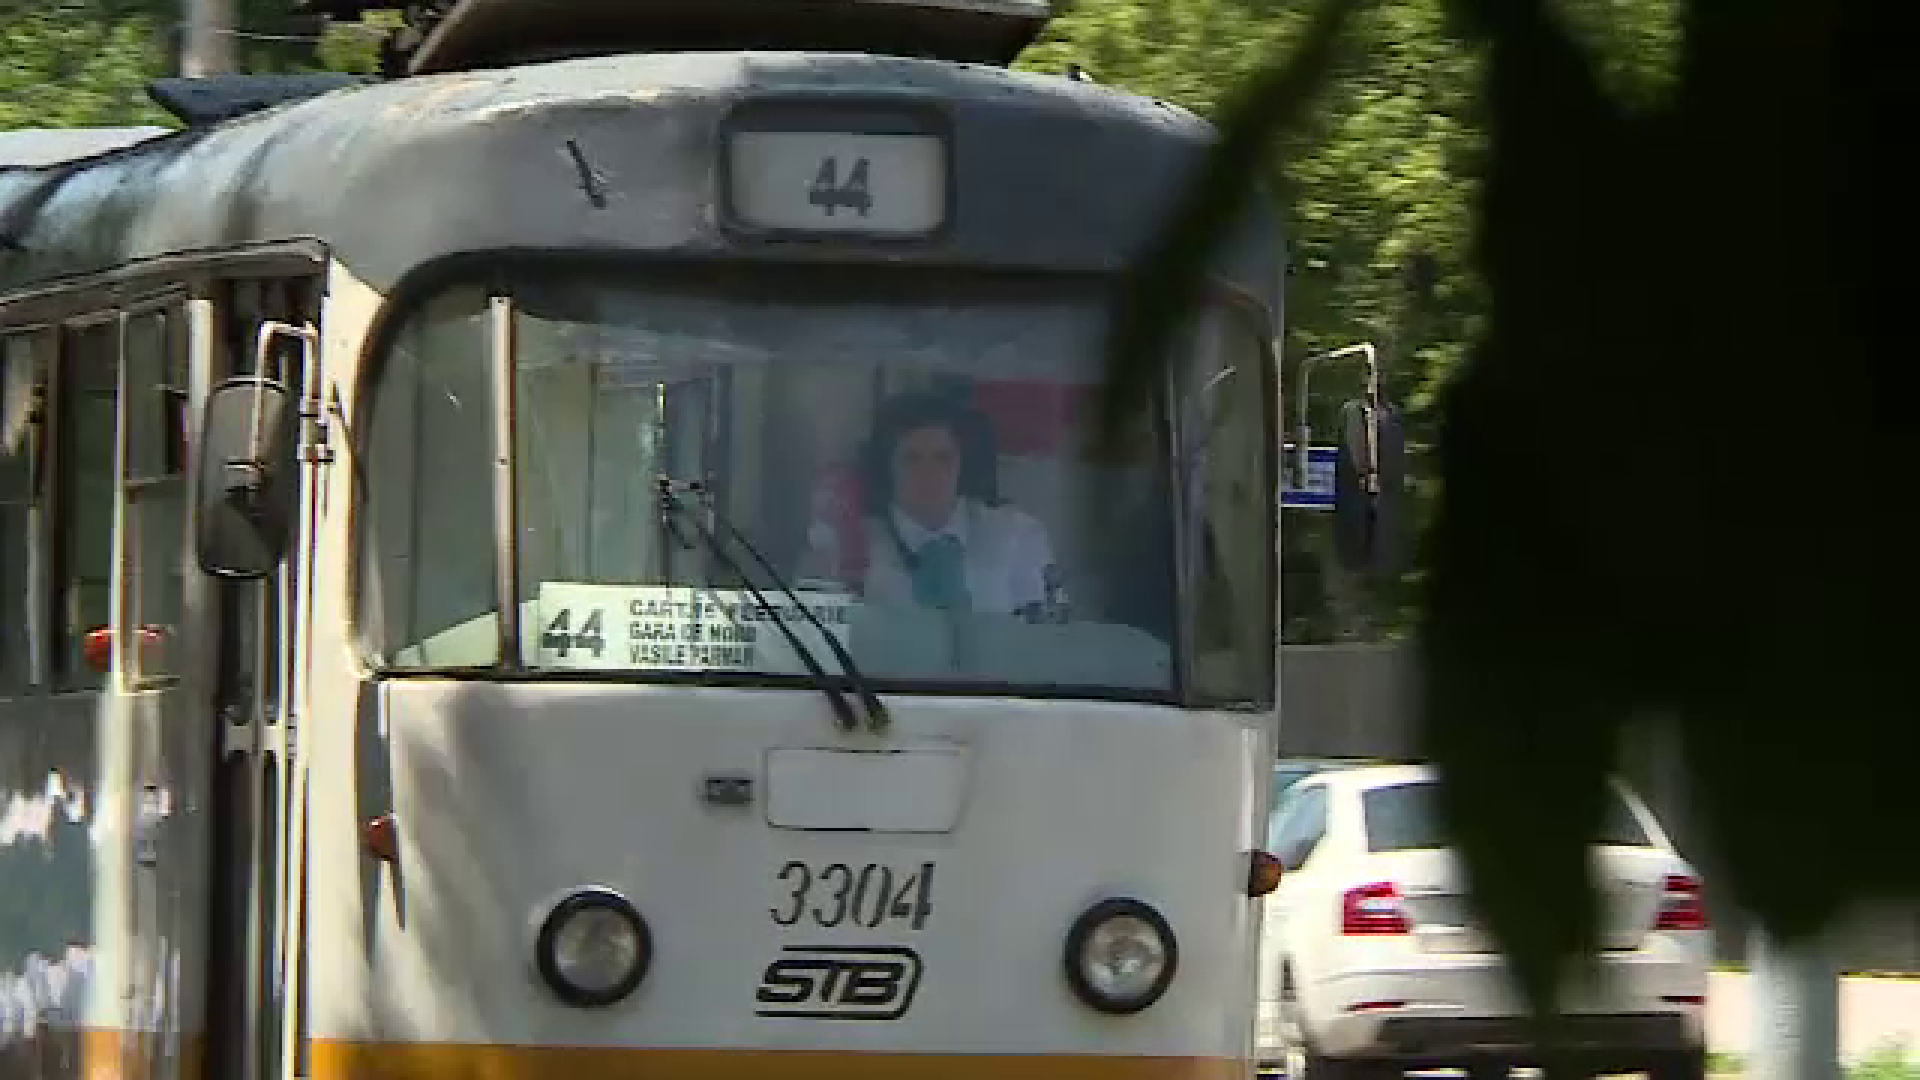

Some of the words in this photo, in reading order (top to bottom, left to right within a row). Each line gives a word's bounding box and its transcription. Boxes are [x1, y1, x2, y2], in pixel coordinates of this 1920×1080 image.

[808, 156, 874, 218] 44
[542, 608, 606, 658] 44
[630, 620, 676, 640] GARA
[681, 623, 702, 642] DE
[630, 644, 685, 664] VASILE
[769, 861, 936, 931] 3304
[755, 959, 905, 1006] STB
